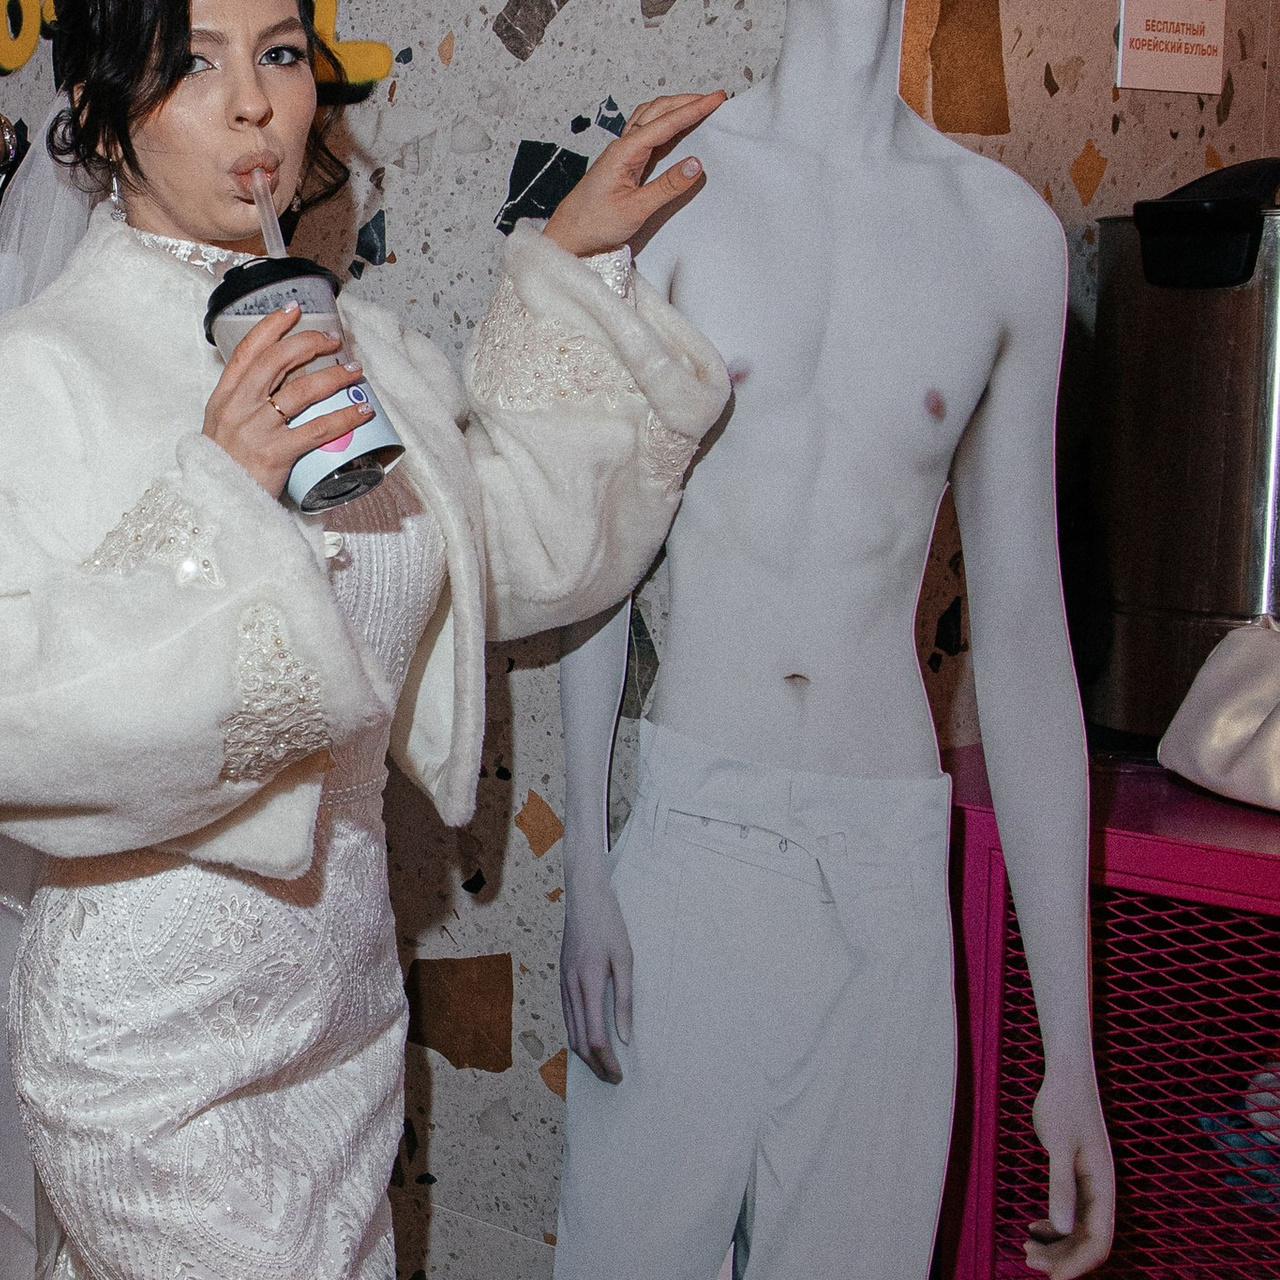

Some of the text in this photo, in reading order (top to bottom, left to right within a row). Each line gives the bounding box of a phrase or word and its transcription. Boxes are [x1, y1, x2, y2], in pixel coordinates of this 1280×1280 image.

[1145, 19, 1206, 37] БЕСПЛАТНЫЙ
[1129, 37, 1218, 57] КОРЕЙСКИЙ БУЛЬОН
